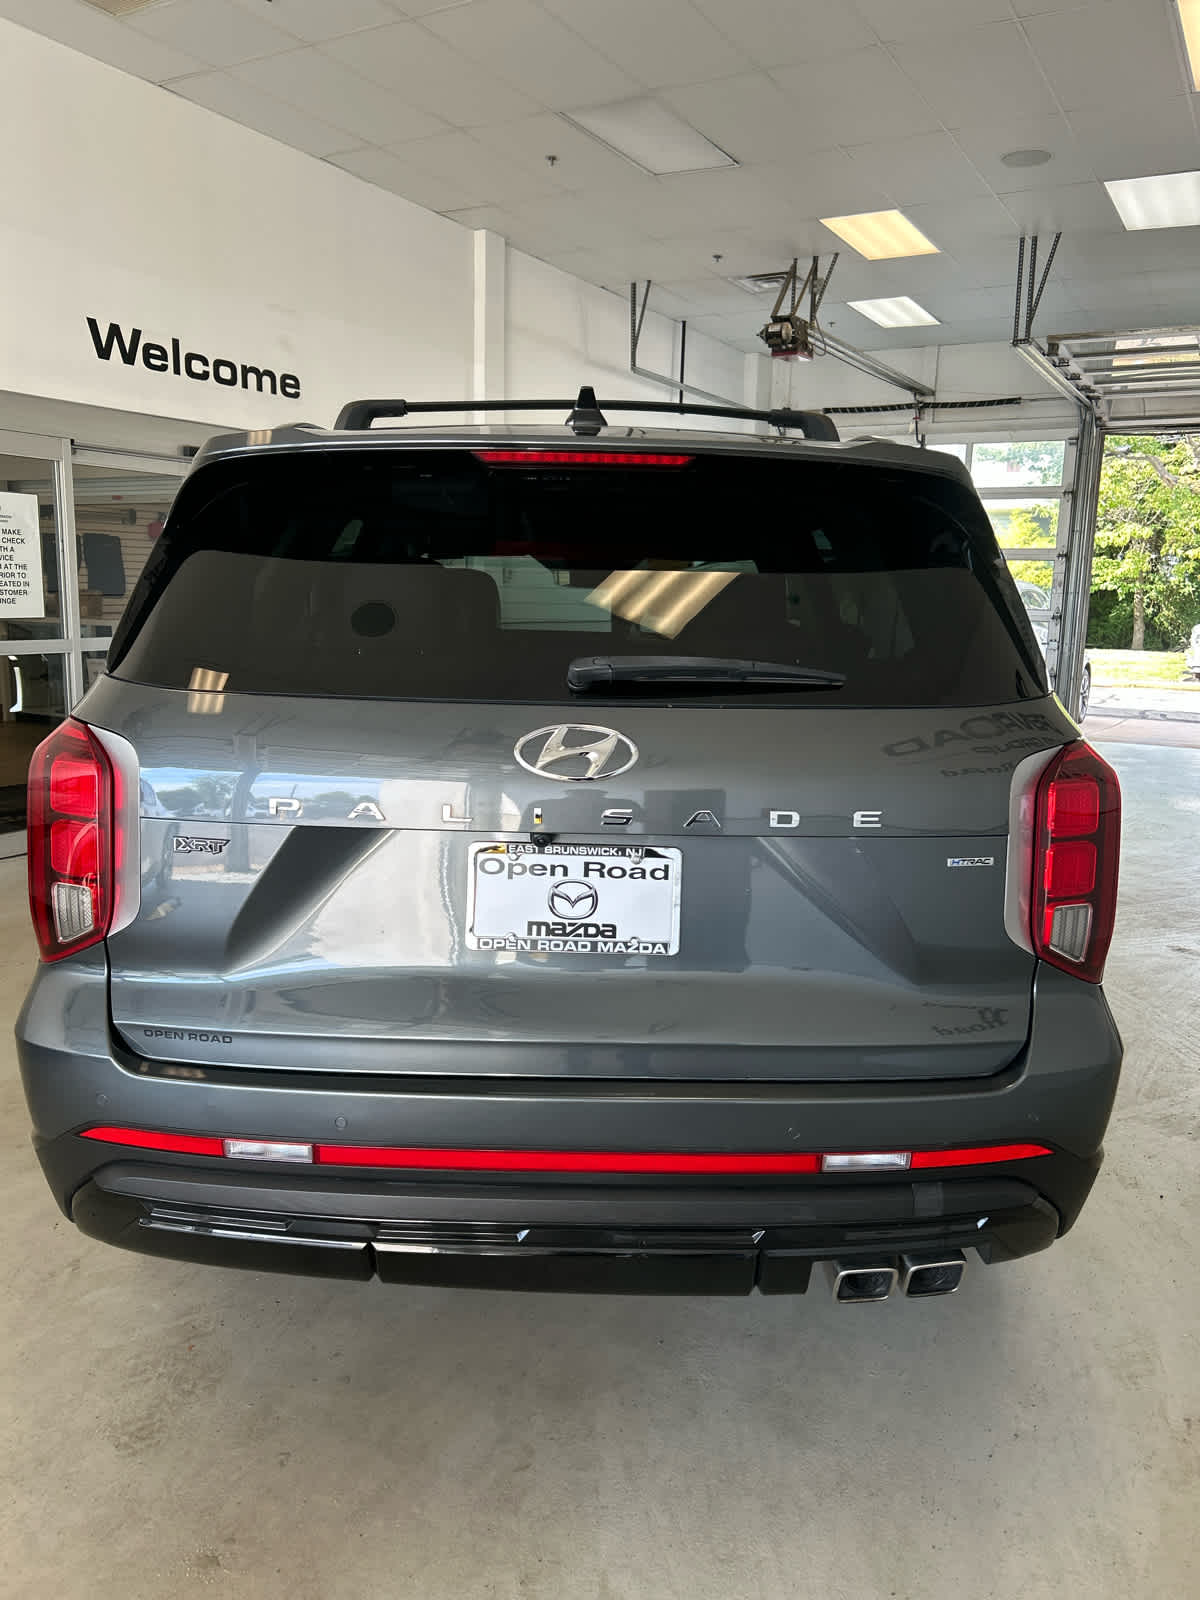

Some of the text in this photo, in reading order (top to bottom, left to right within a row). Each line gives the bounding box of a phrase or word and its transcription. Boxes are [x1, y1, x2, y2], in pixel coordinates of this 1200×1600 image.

[86, 316, 301, 399] Welcome
[1, 536, 26, 545] CHECK
[14, 563, 28, 571] THE
[17, 571, 27, 579] TO
[268, 797, 883, 829] PALISADE
[173, 836, 230, 855] XRT
[508, 844, 539, 855] EAST
[625, 847, 642, 858] NJ
[478, 857, 670, 881] Open Road
[949, 857, 992, 866] HTRAC
[479, 938, 666, 954] OPEN ROAD MAZDA
[143, 1028, 233, 1044] OPEN ROAD
